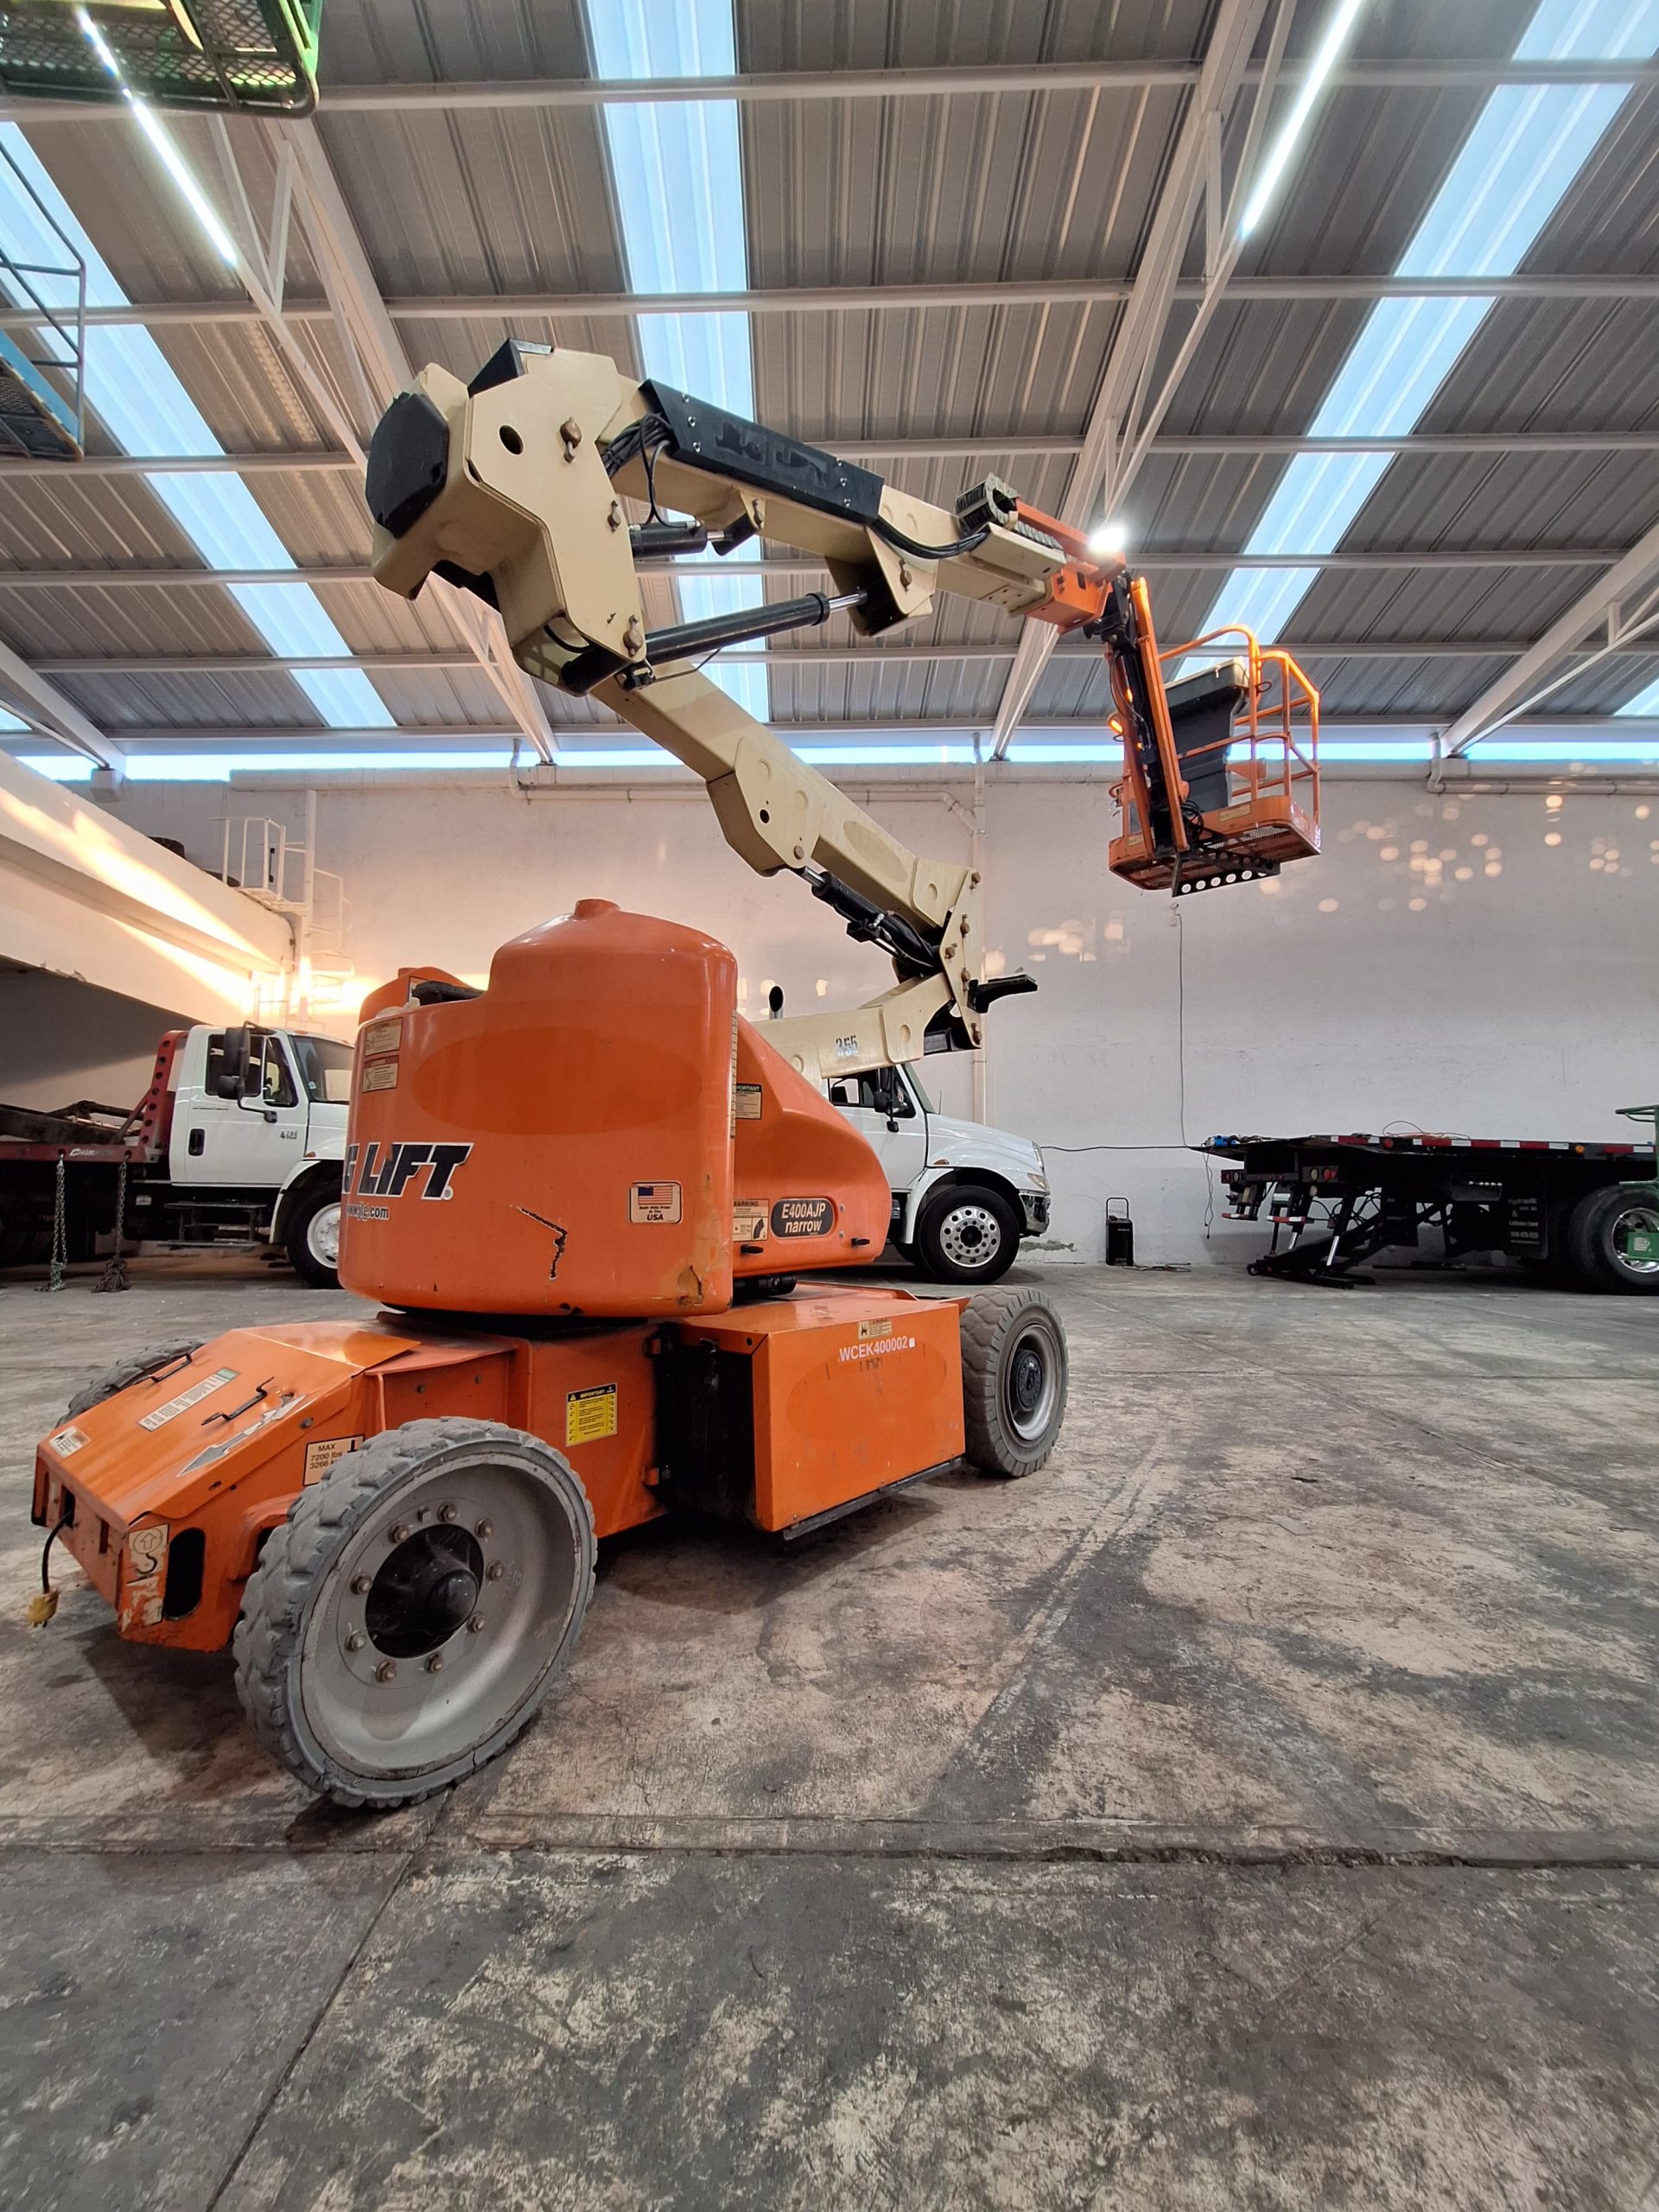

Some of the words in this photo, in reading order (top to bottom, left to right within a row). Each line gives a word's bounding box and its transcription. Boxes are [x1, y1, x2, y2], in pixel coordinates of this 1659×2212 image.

[357, 1141, 474, 1200] LIFT
[781, 1202, 826, 1219] E400AJP
[785, 1219, 823, 1234] narrow
[839, 1335, 908, 1363] WCEK400002
[580, 1389, 606, 1399] IMPORTANT
[318, 1443, 336, 1452] MAX
[311, 1452, 330, 1462] 7200
[310, 1460, 329, 1470] 3266
